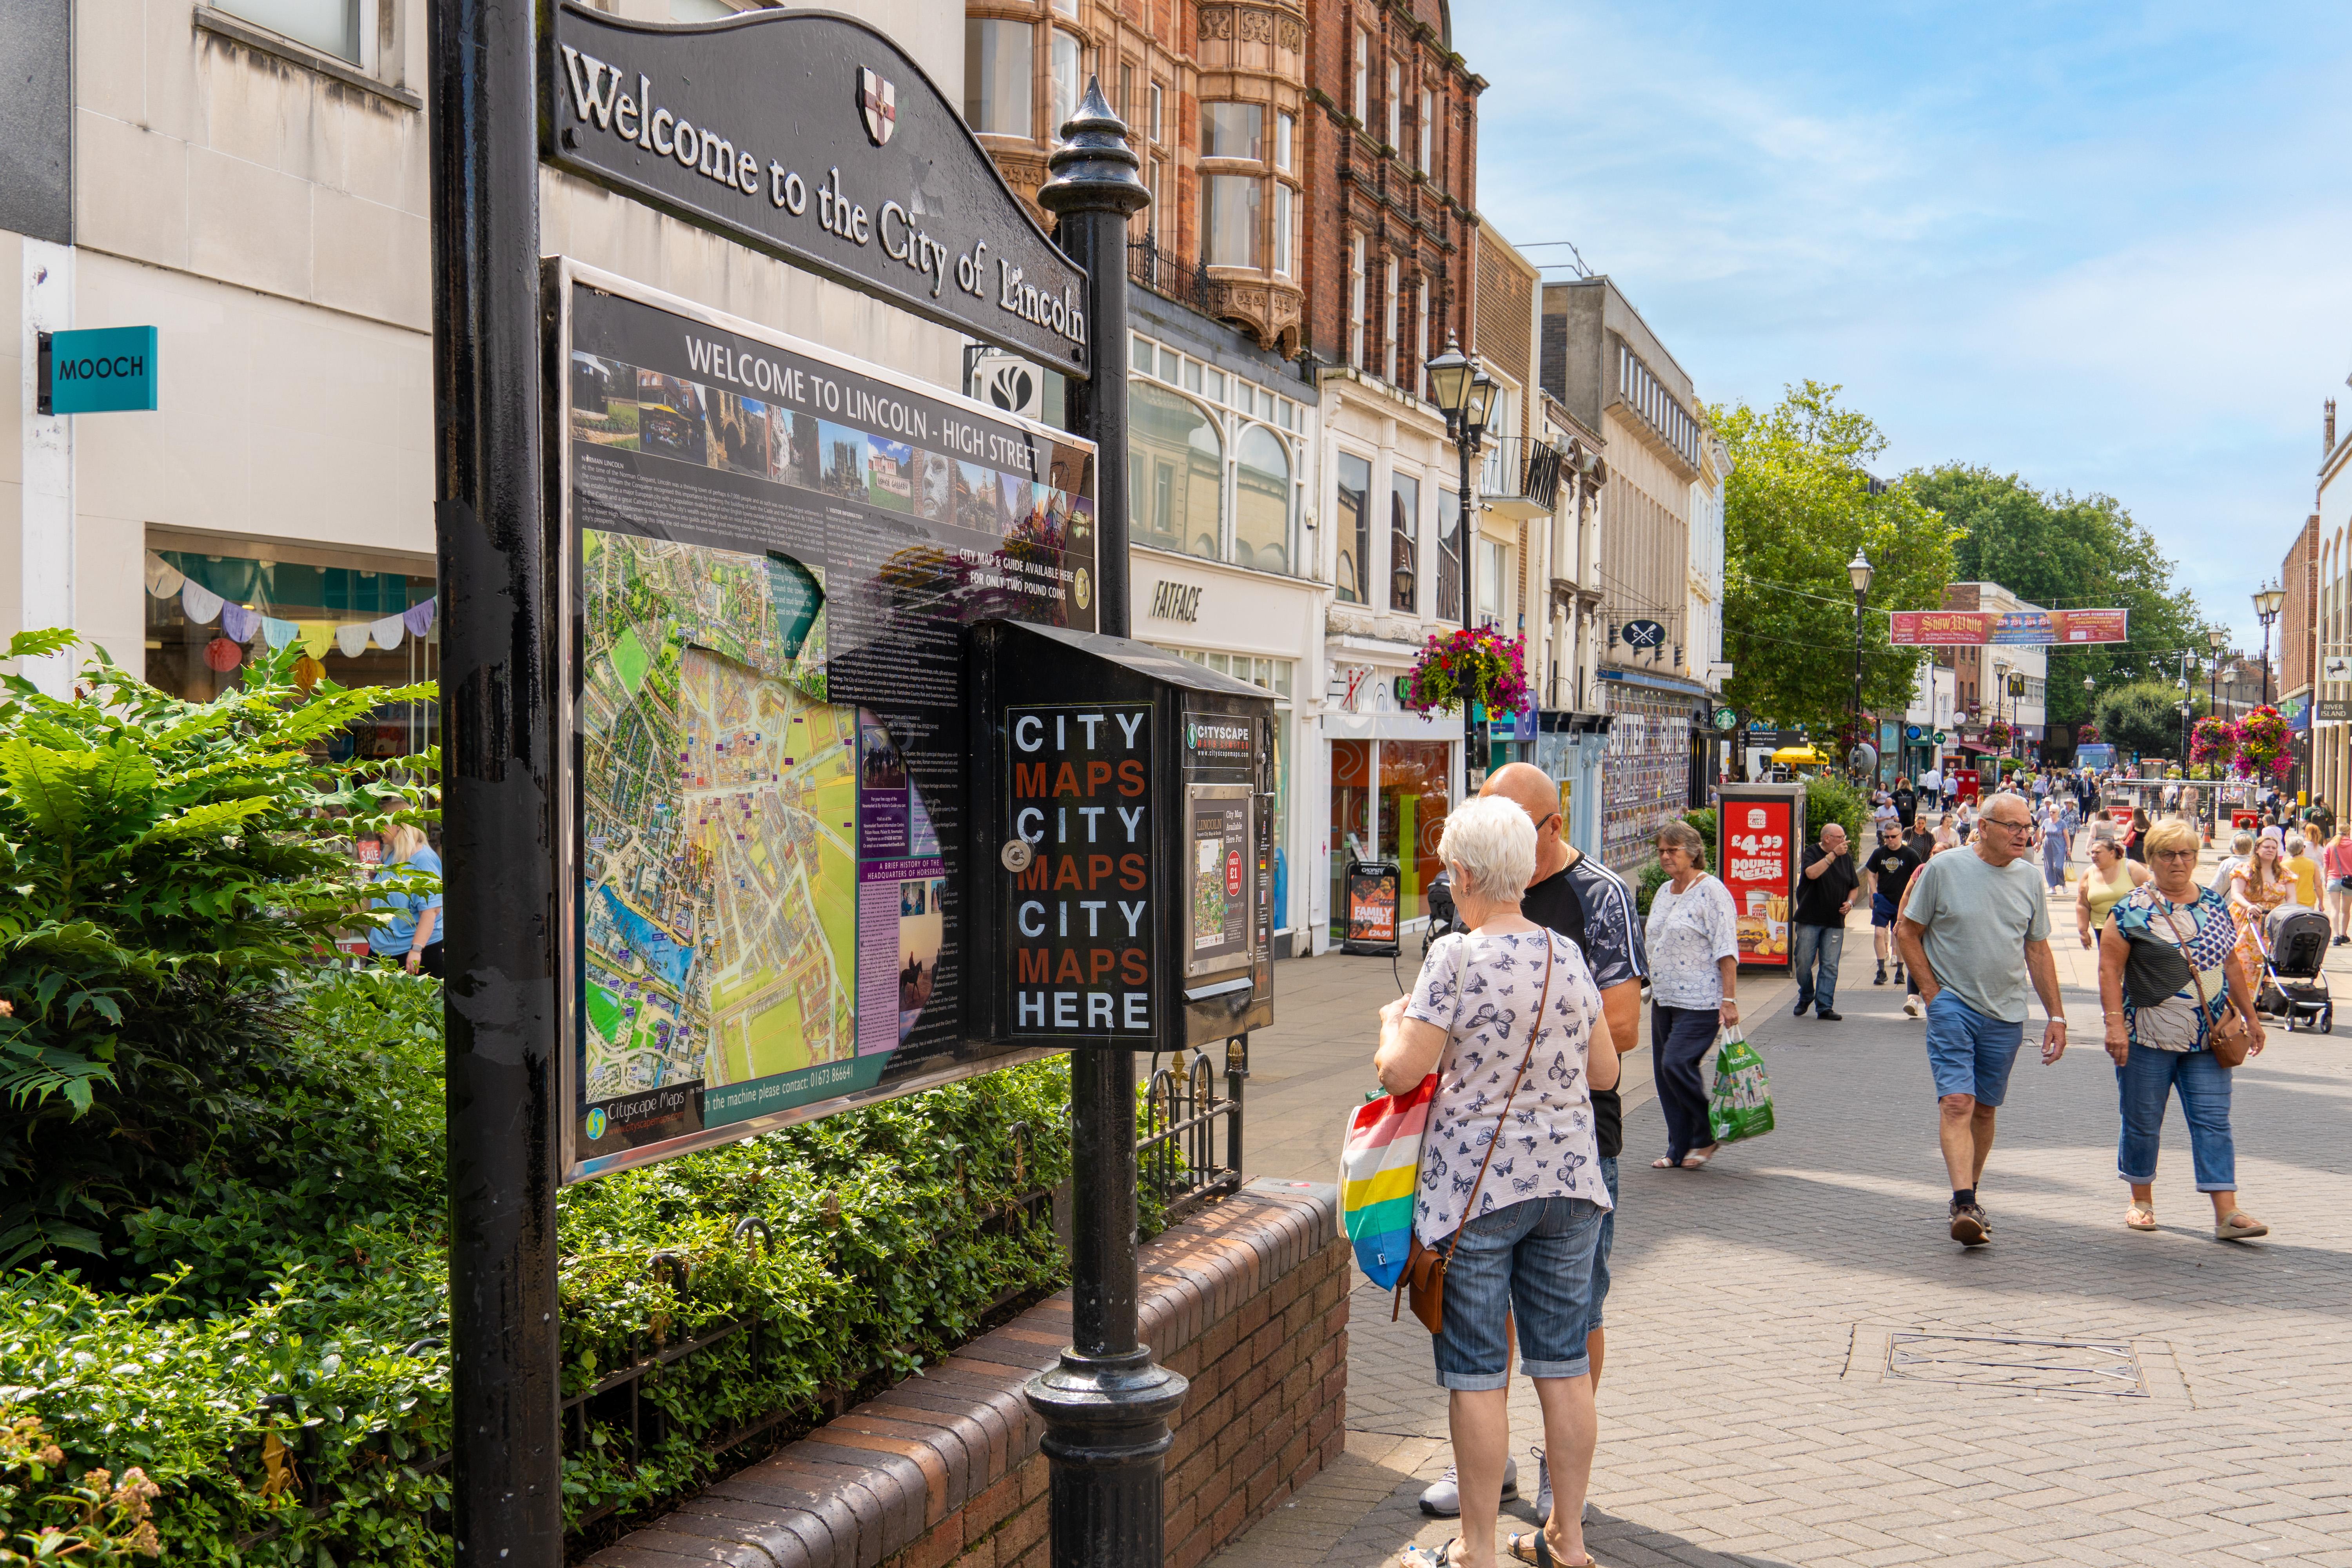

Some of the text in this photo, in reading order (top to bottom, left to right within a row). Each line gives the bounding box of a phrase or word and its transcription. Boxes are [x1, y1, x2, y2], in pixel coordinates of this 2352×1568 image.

[561, 44, 1085, 345] Welcome to the City of Lincoln
[59, 356, 143, 380] MOOCH
[685, 335, 1040, 472] WELCOME TO LINCOLN HIGH STREET
[582, 456, 624, 468] NORMAN LINCOLN
[637, 475, 656, 483] Conquest,
[878, 477, 908, 490] USHER GALLERY
[960, 548, 1073, 583] CITY MAP & GUIDE AVAILABLE HERE
[785, 575, 793, 584] large
[971, 572, 1065, 600] FOR ONLY TWO POUND COINS
[1152, 580, 1203, 622] FATFACE
[791, 609, 811, 618] Newmarket
[1918, 615, 1982, 634] Snow White
[1016, 712, 1144, 753] CITY
[1198, 726, 1248, 740] CITYSCAPE
[1609, 712, 1688, 757] GUTTER GUTTER
[1198, 750, 1249, 759] www.cityscapemaps.com
[1221, 740, 1248, 750] LIMITED
[1016, 760, 1144, 799] MAPS
[1017, 806, 1145, 844] CITY
[1197, 819, 1222, 830] LINCOLN
[1226, 822, 1242, 831] Available
[1731, 835, 1782, 855] £4.99
[361, 850, 379, 861] SALE
[1731, 858, 1781, 870] DOUBLE
[868, 871, 906, 880] HEADQUARTERS
[917, 867, 945, 876] HORSERACIN
[1017, 853, 1146, 891] MAPS
[1230, 867, 1237, 879] £1
[1731, 866, 1782, 880] MELTS
[1018, 900, 1146, 937] CITY
[1354, 906, 1392, 917] FAMILY
[1019, 949, 1147, 985] MAPS
[1019, 991, 1149, 1029] HERE
[713, 1063, 853, 1109] the machine please contact: 01673 866641
[608, 1091, 684, 1122] Cityscape Maps
[608, 1111, 684, 1136] www.cityscapemaps.com
